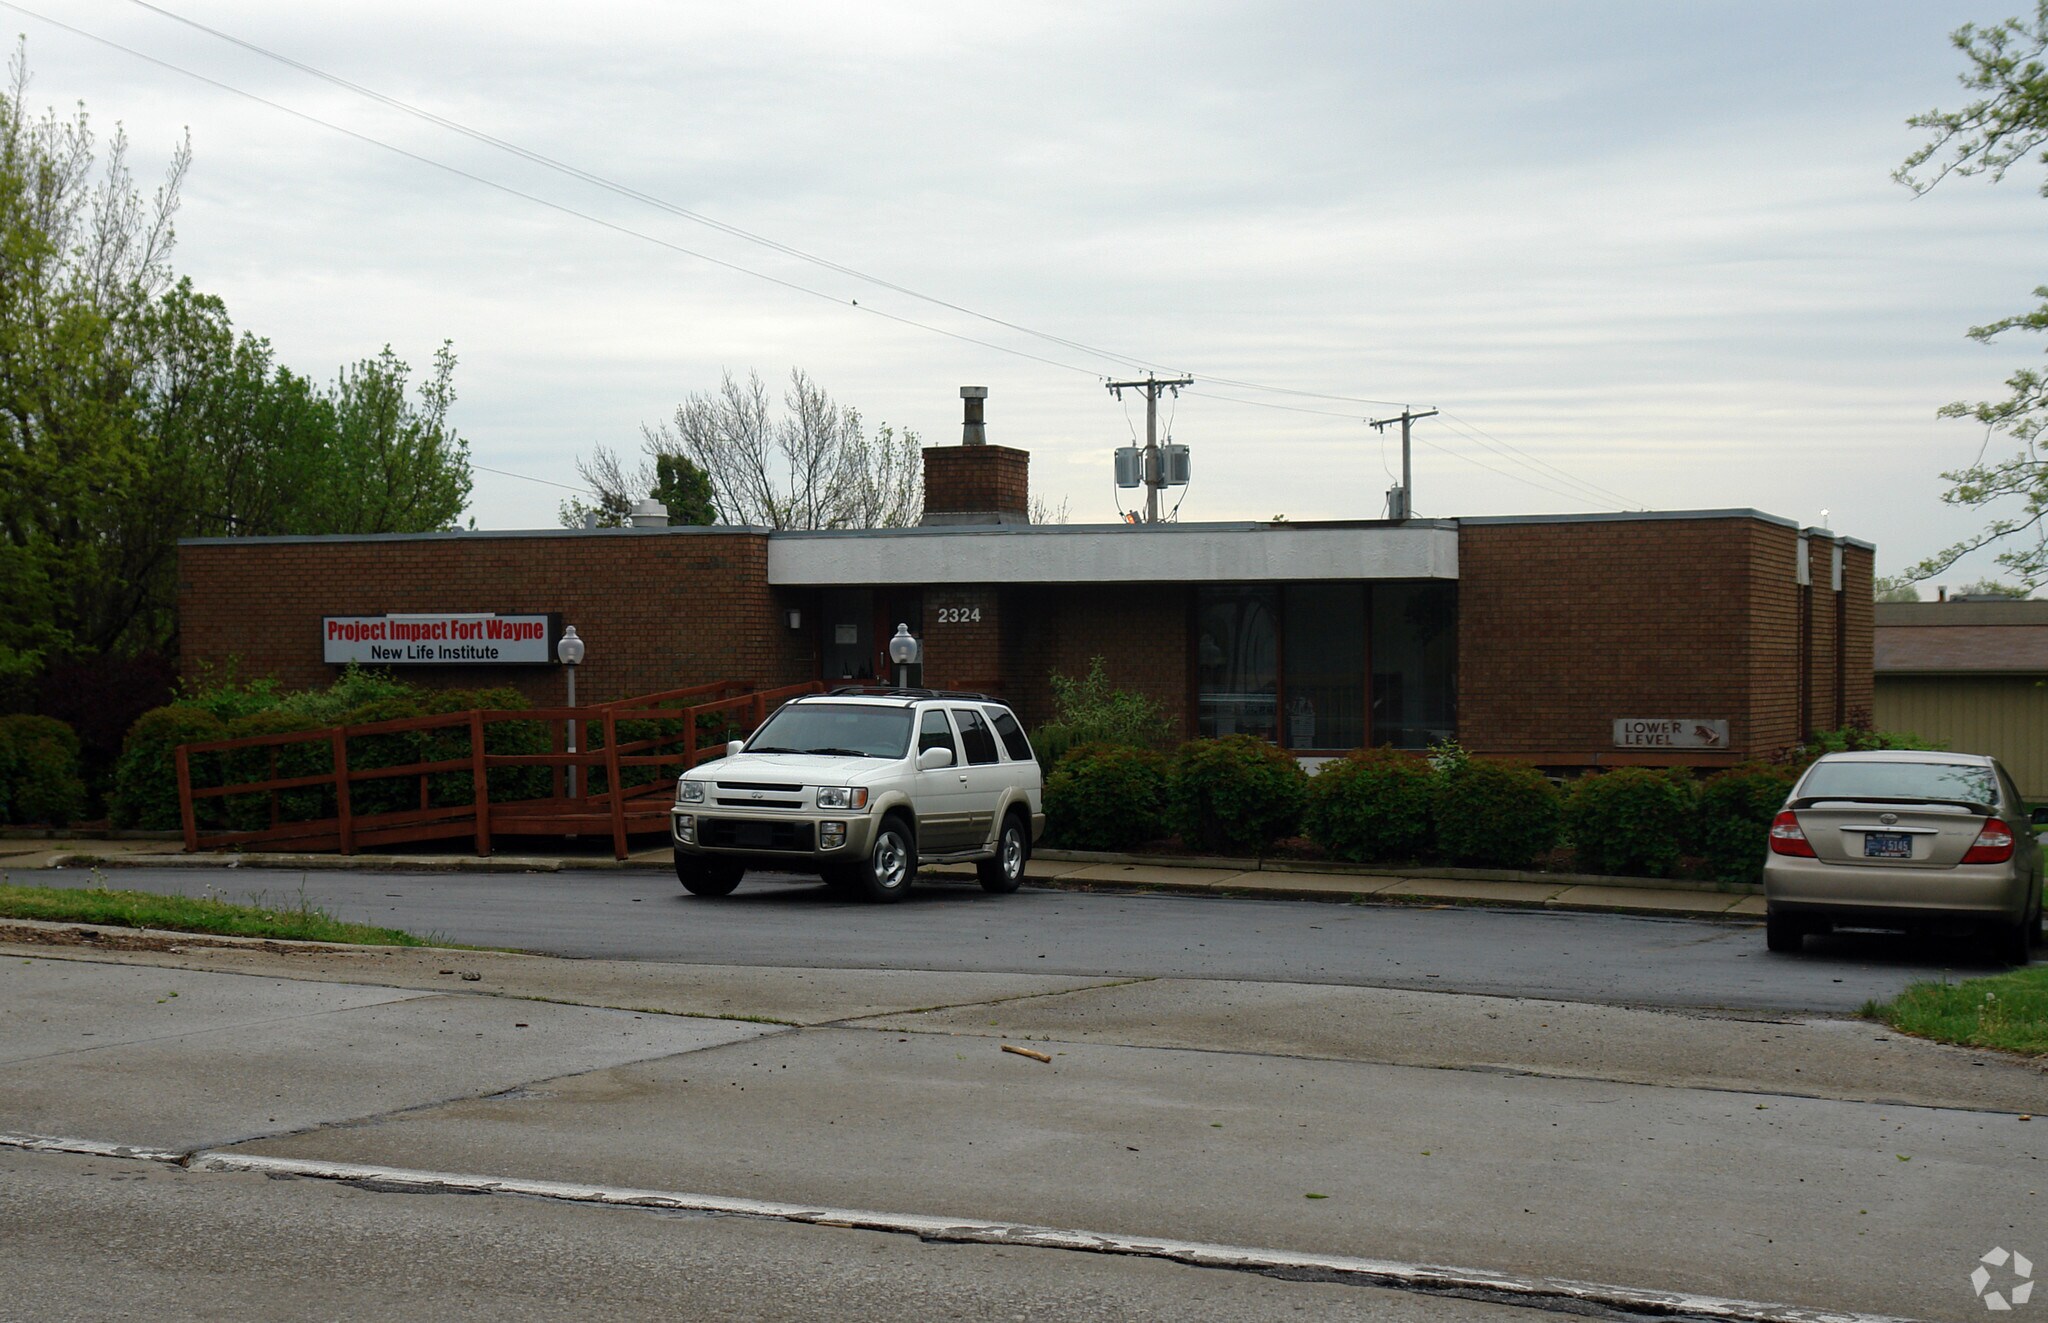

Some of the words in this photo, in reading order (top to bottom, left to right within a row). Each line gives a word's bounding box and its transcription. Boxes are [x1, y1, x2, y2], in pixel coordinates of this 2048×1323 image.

[938, 608, 981, 623] 2324
[328, 621, 386, 642] Project
[389, 620, 447, 642] Impact
[451, 620, 483, 640] Fort
[486, 619, 544, 641] Wayne
[371, 645, 402, 659] New
[407, 645, 434, 659] Life
[439, 645, 499, 659] Institute
[1625, 722, 1682, 734] LOWER
[1625, 734, 1673, 745] LEVEL
